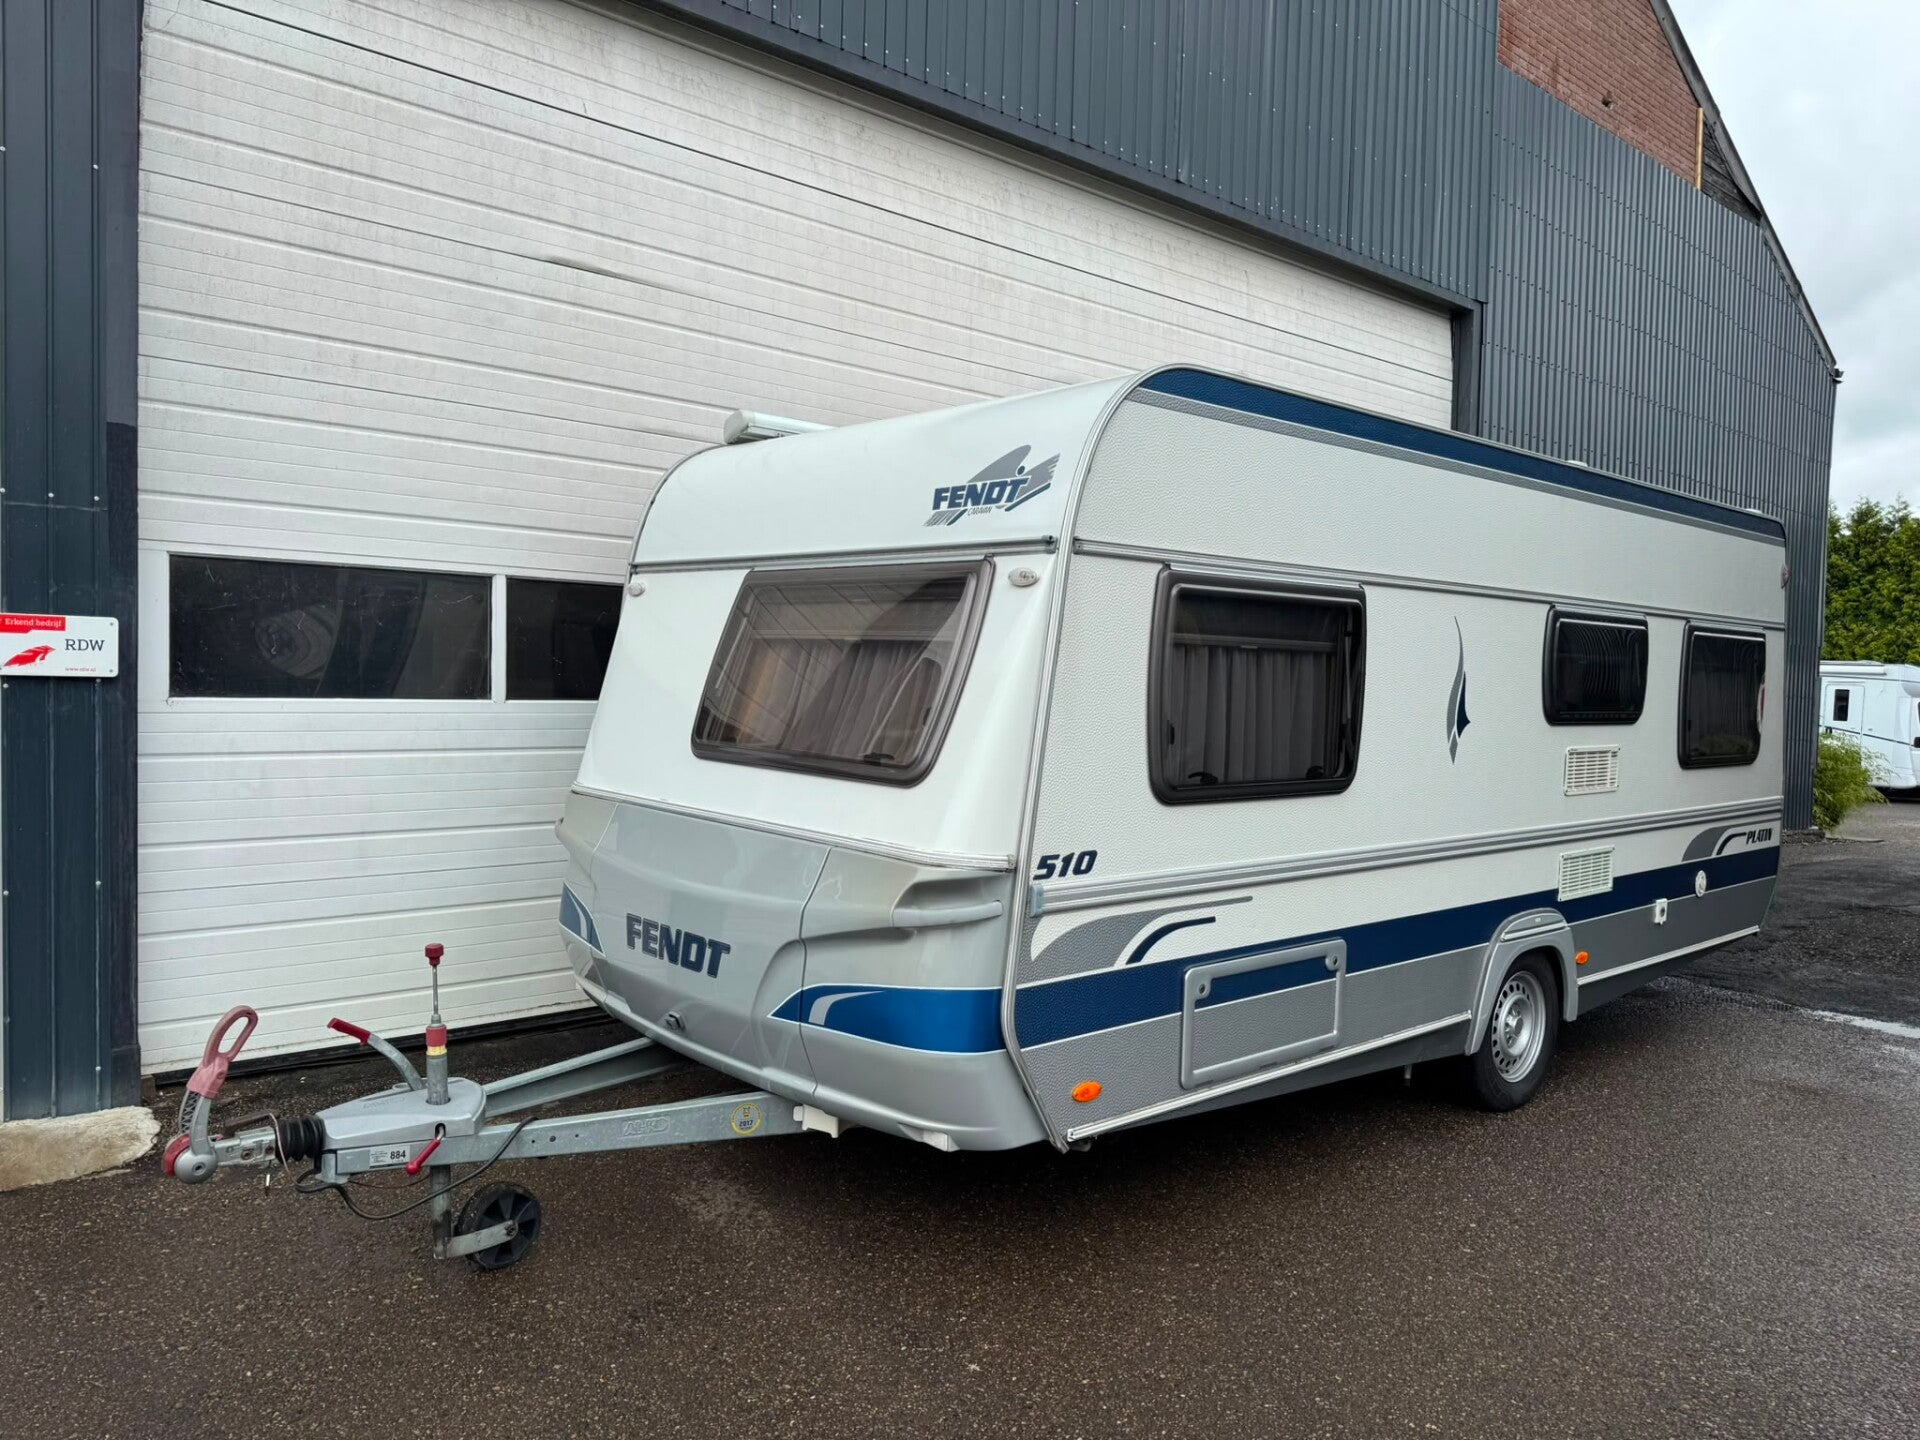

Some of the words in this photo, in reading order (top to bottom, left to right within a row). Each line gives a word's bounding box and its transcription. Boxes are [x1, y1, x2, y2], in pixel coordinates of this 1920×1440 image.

[932, 477, 1030, 511] FENDT
[5, 618, 34, 627] Erkend
[35, 618, 62, 629] bedrijf
[65, 638, 105, 651] RDW
[1746, 827, 1773, 845] PLATIN
[1032, 849, 1098, 881] 510
[626, 912, 732, 979] FENDT
[739, 1119, 754, 1127] 2017
[389, 1149, 407, 1160] 884
